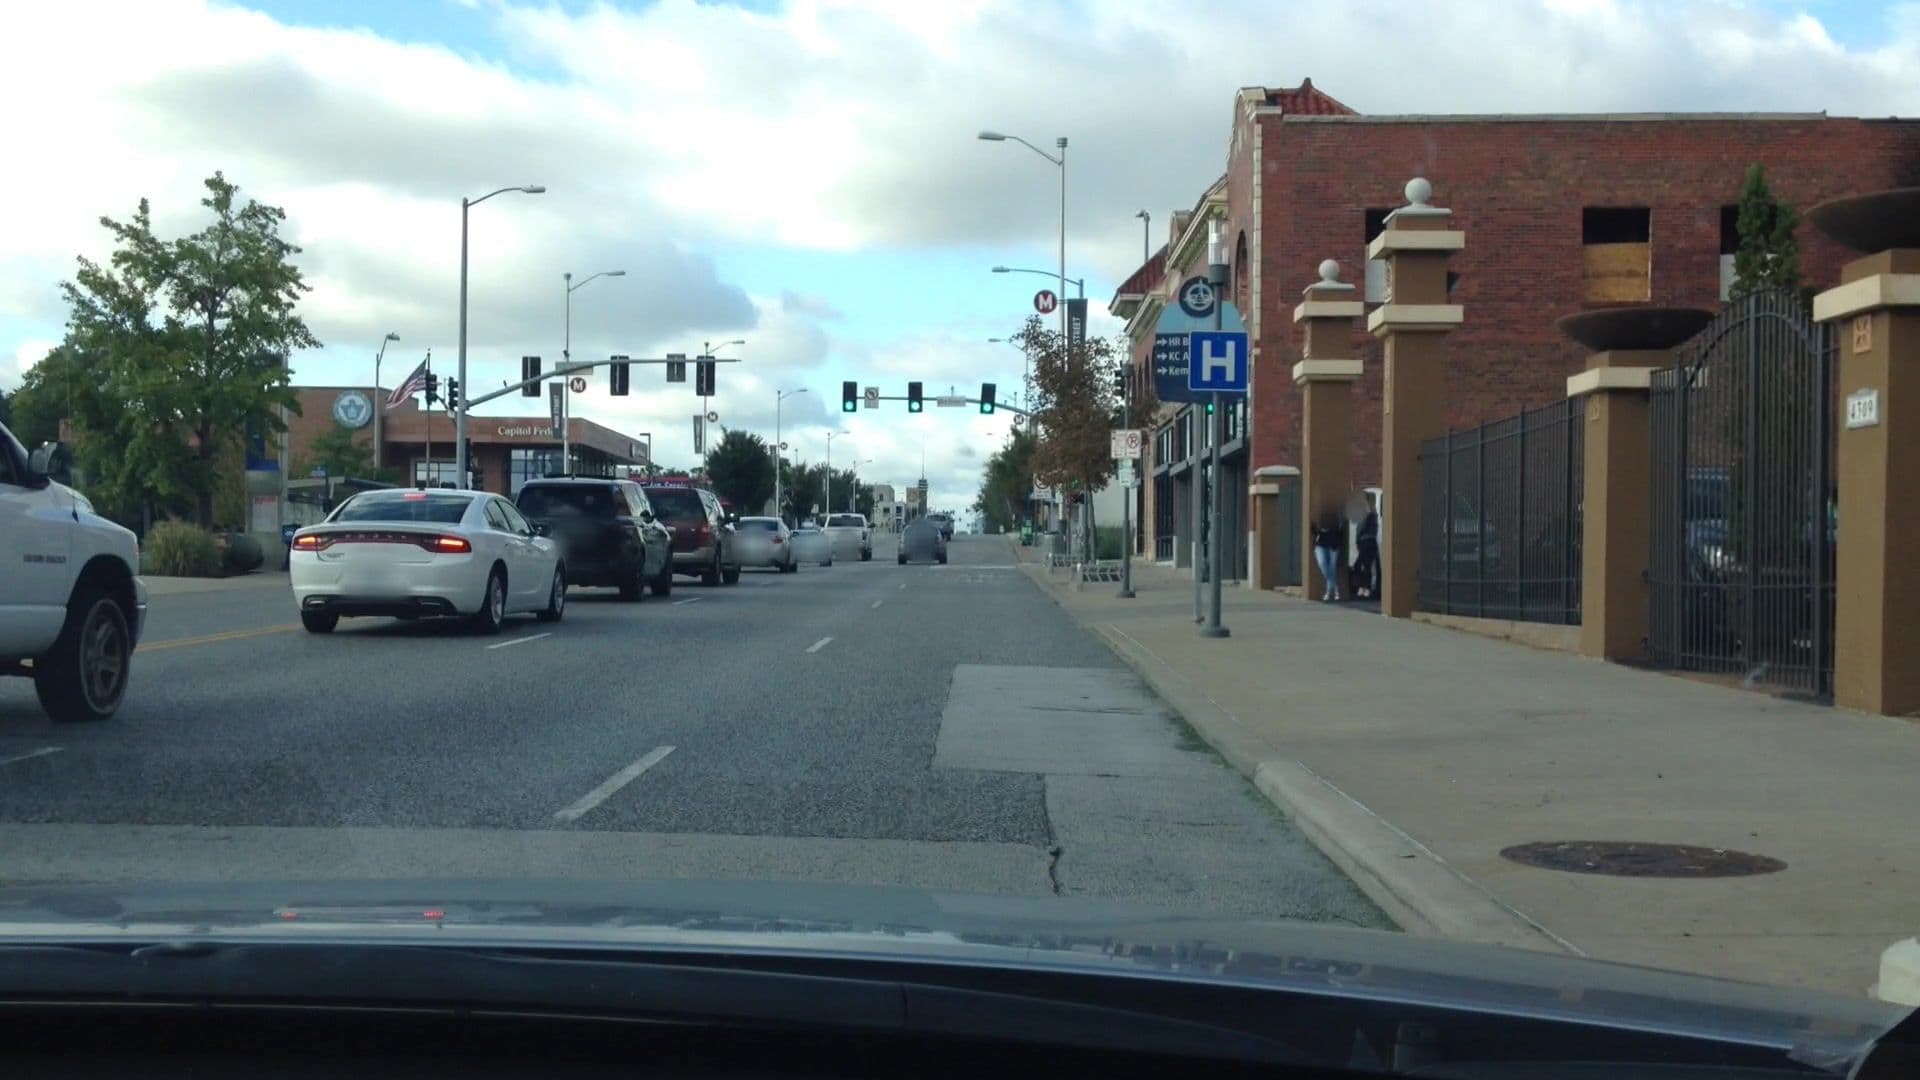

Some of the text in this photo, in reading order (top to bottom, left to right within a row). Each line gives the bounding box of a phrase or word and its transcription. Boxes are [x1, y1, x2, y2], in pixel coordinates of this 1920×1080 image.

[1038, 294, 1053, 310] M
[1168, 351, 1180, 361] KC
[1202, 340, 1236, 382] H
[572, 379, 583, 391] M
[497, 425, 531, 437] Capitol
